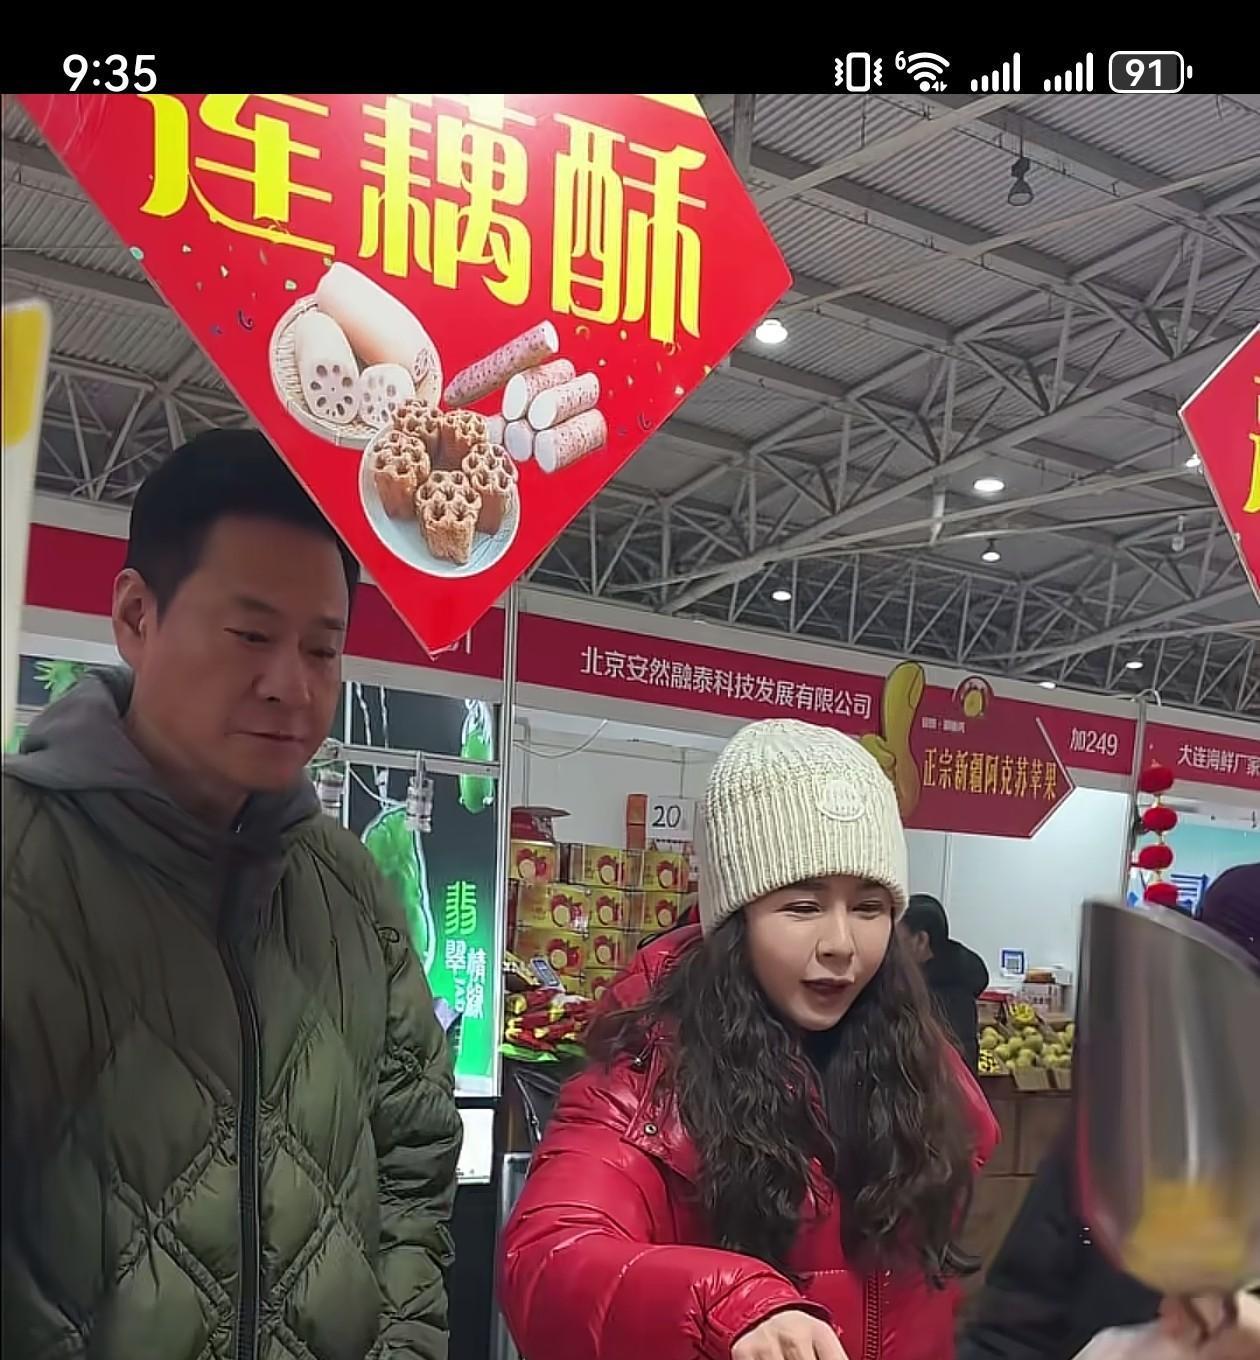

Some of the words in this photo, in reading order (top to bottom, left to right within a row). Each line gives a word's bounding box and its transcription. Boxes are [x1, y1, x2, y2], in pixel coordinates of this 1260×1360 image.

[580, 645, 872, 719] 北京安然融泰科技发展有限公司
[923, 747, 1058, 801] 正宗新疆阿克苏苹果
[652, 804, 682, 828] 20
